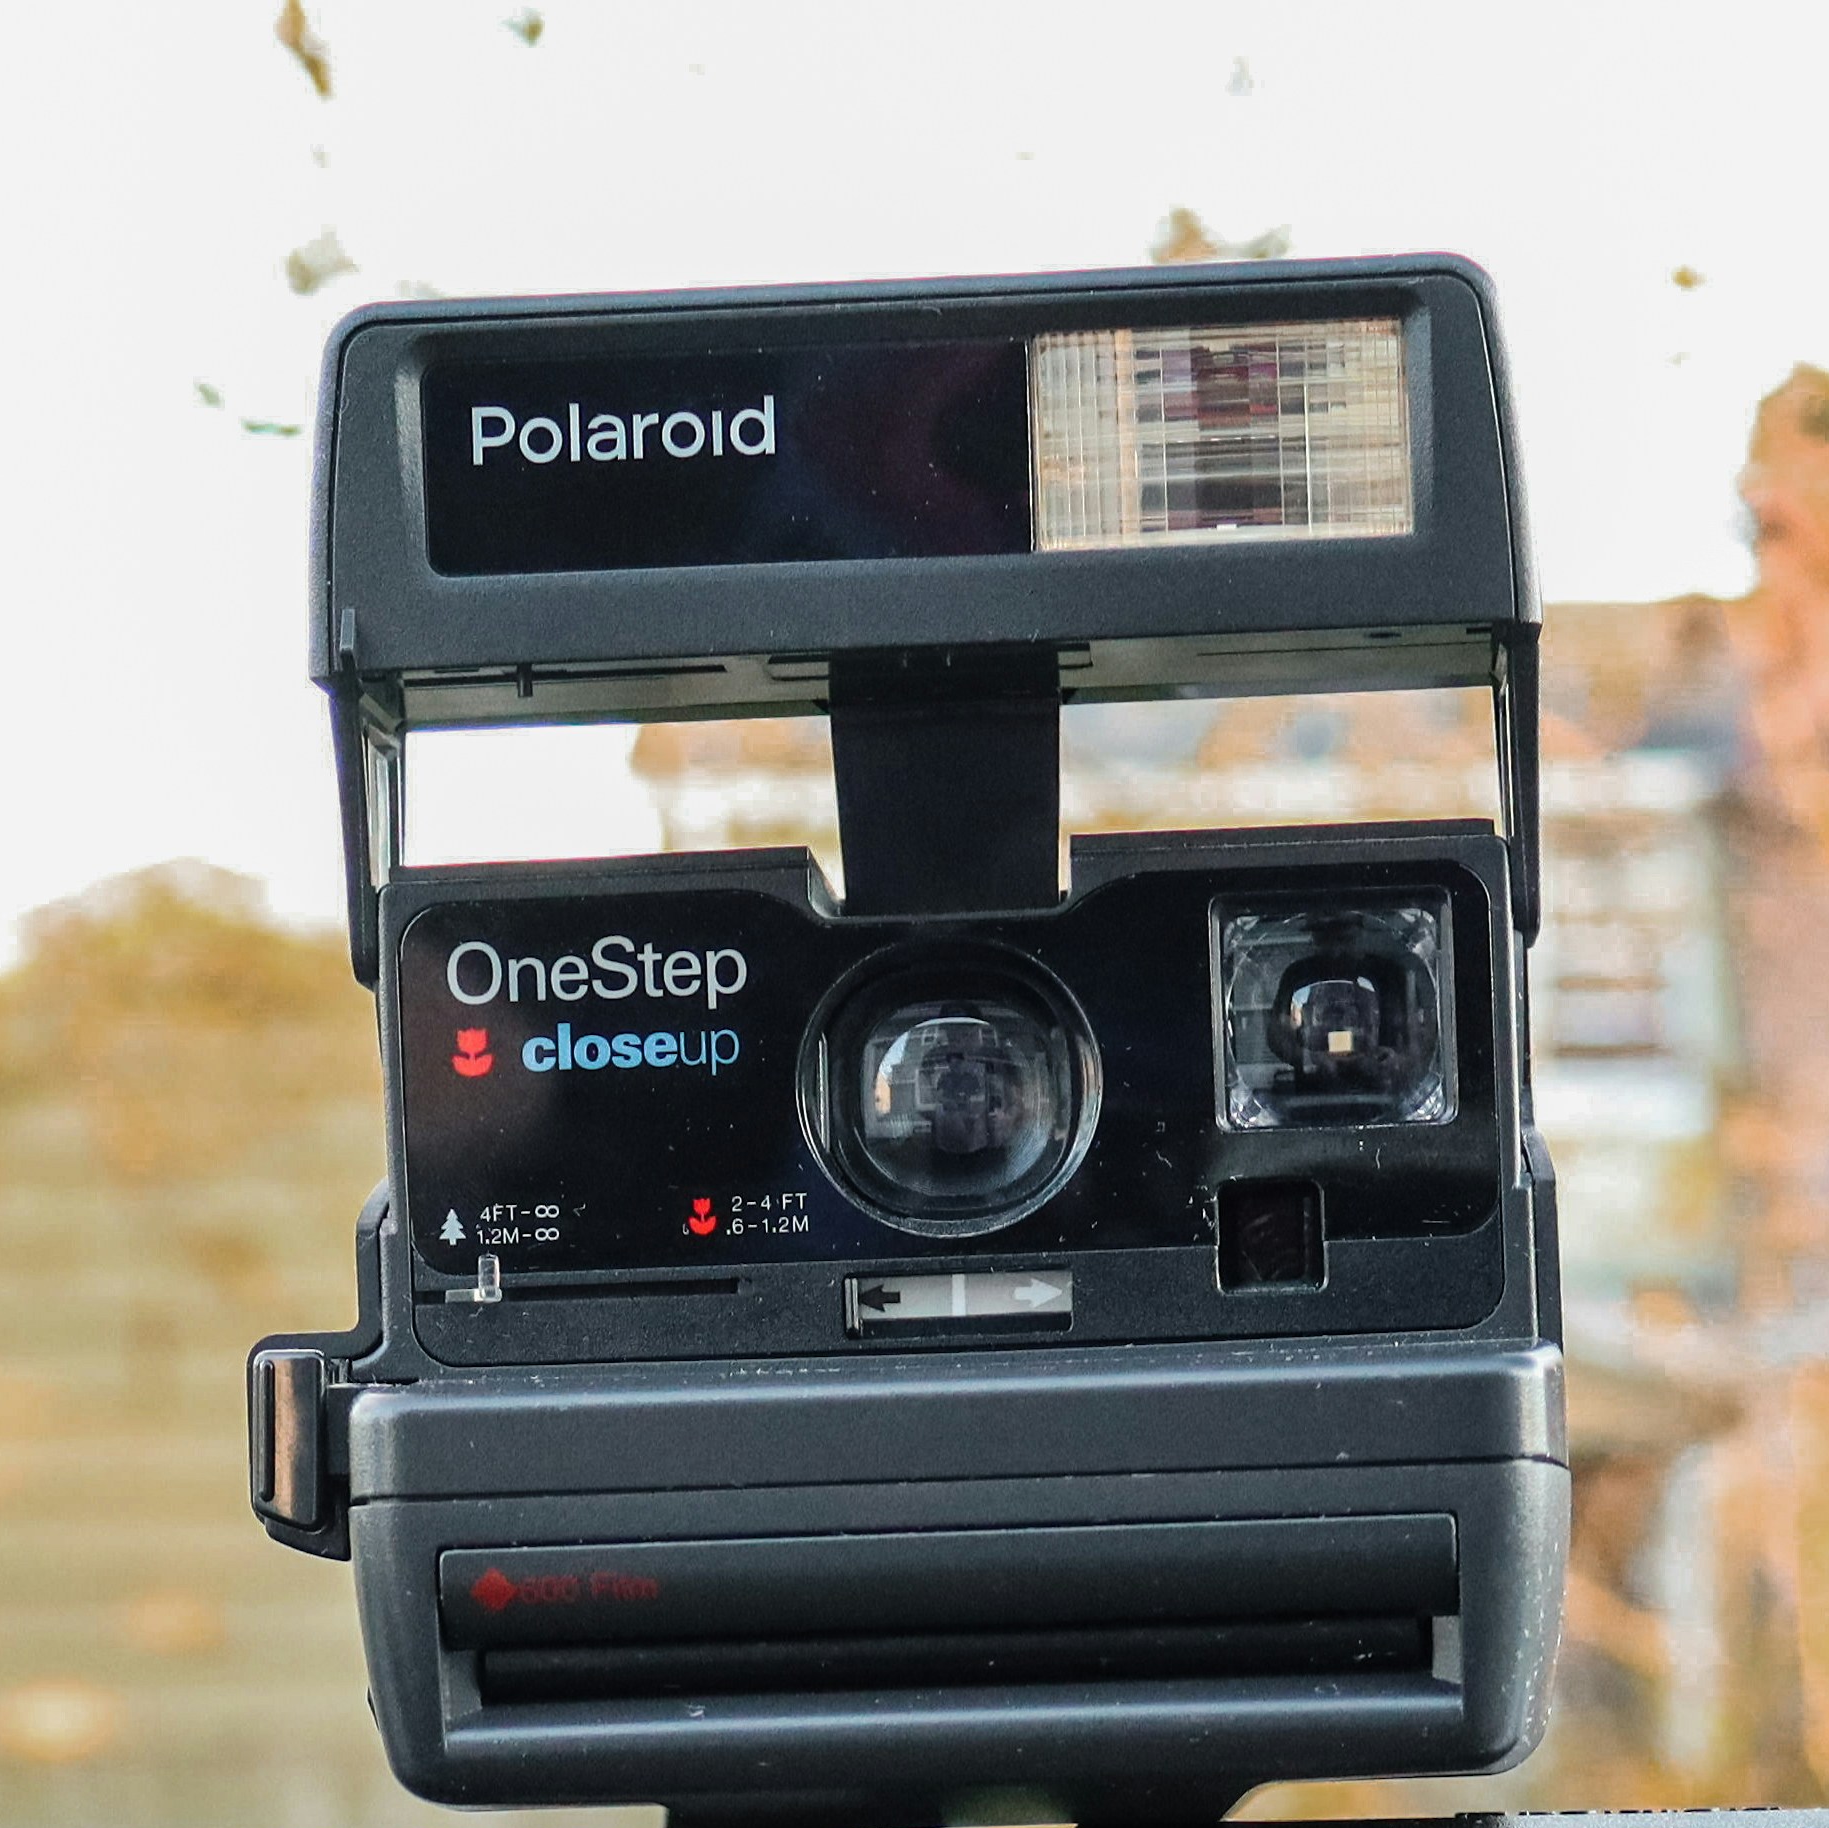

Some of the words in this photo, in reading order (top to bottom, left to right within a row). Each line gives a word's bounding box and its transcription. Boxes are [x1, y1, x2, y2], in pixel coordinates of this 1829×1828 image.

[471, 394, 776, 466] Polaroid
[446, 935, 748, 1010] OneStep
[521, 1022, 741, 1076] closeup
